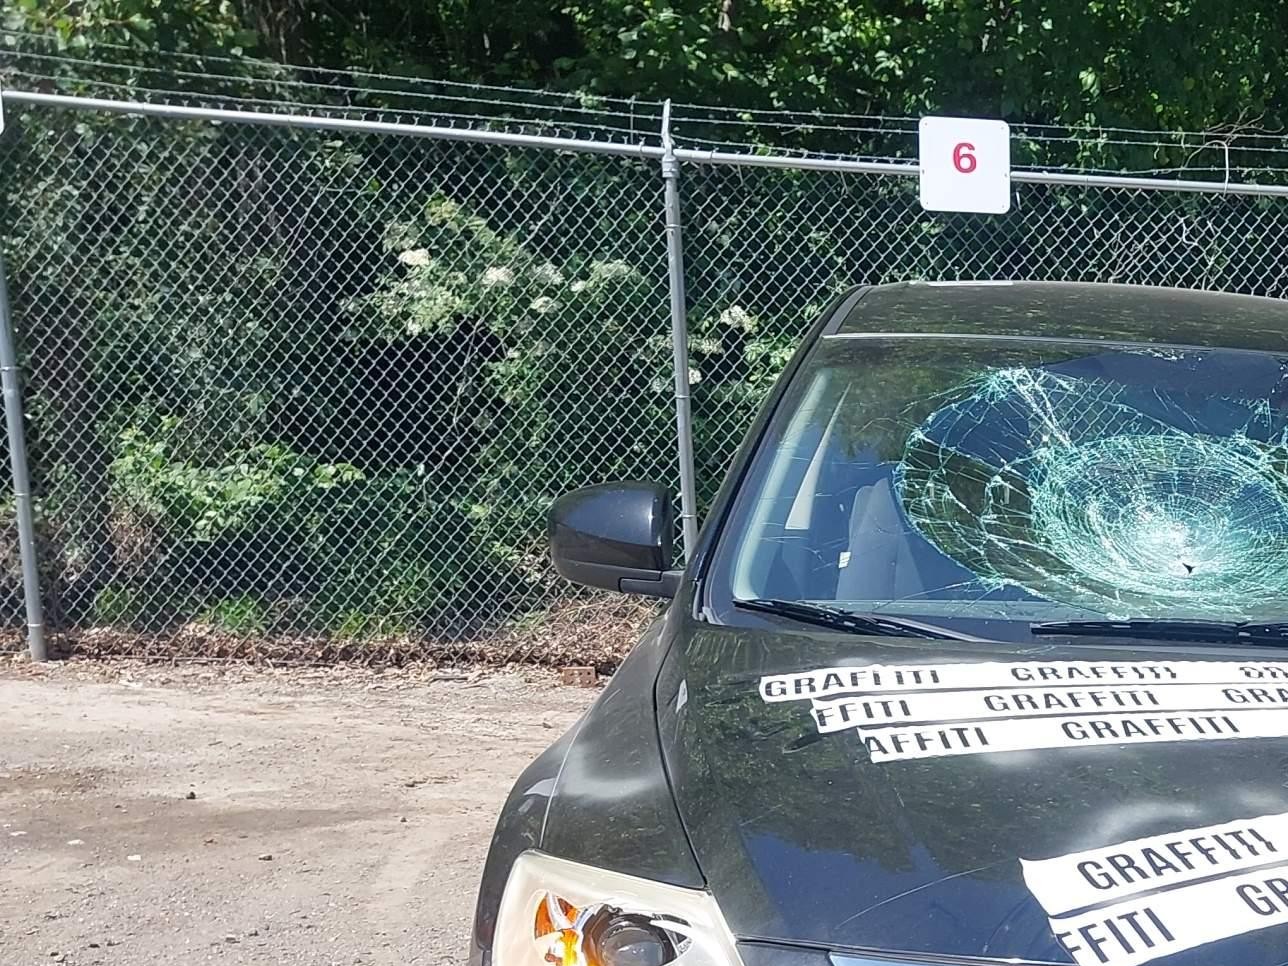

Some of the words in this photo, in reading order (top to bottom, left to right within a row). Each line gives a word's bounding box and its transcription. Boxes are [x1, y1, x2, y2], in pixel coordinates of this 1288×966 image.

[952, 142, 977, 173] 6
[983, 690, 1160, 712] GRAFFITI
[864, 727, 990, 754] AFFITI
[1061, 716, 1241, 740] GRAFFITI
[1076, 828, 1278, 891] GRAFFITI
